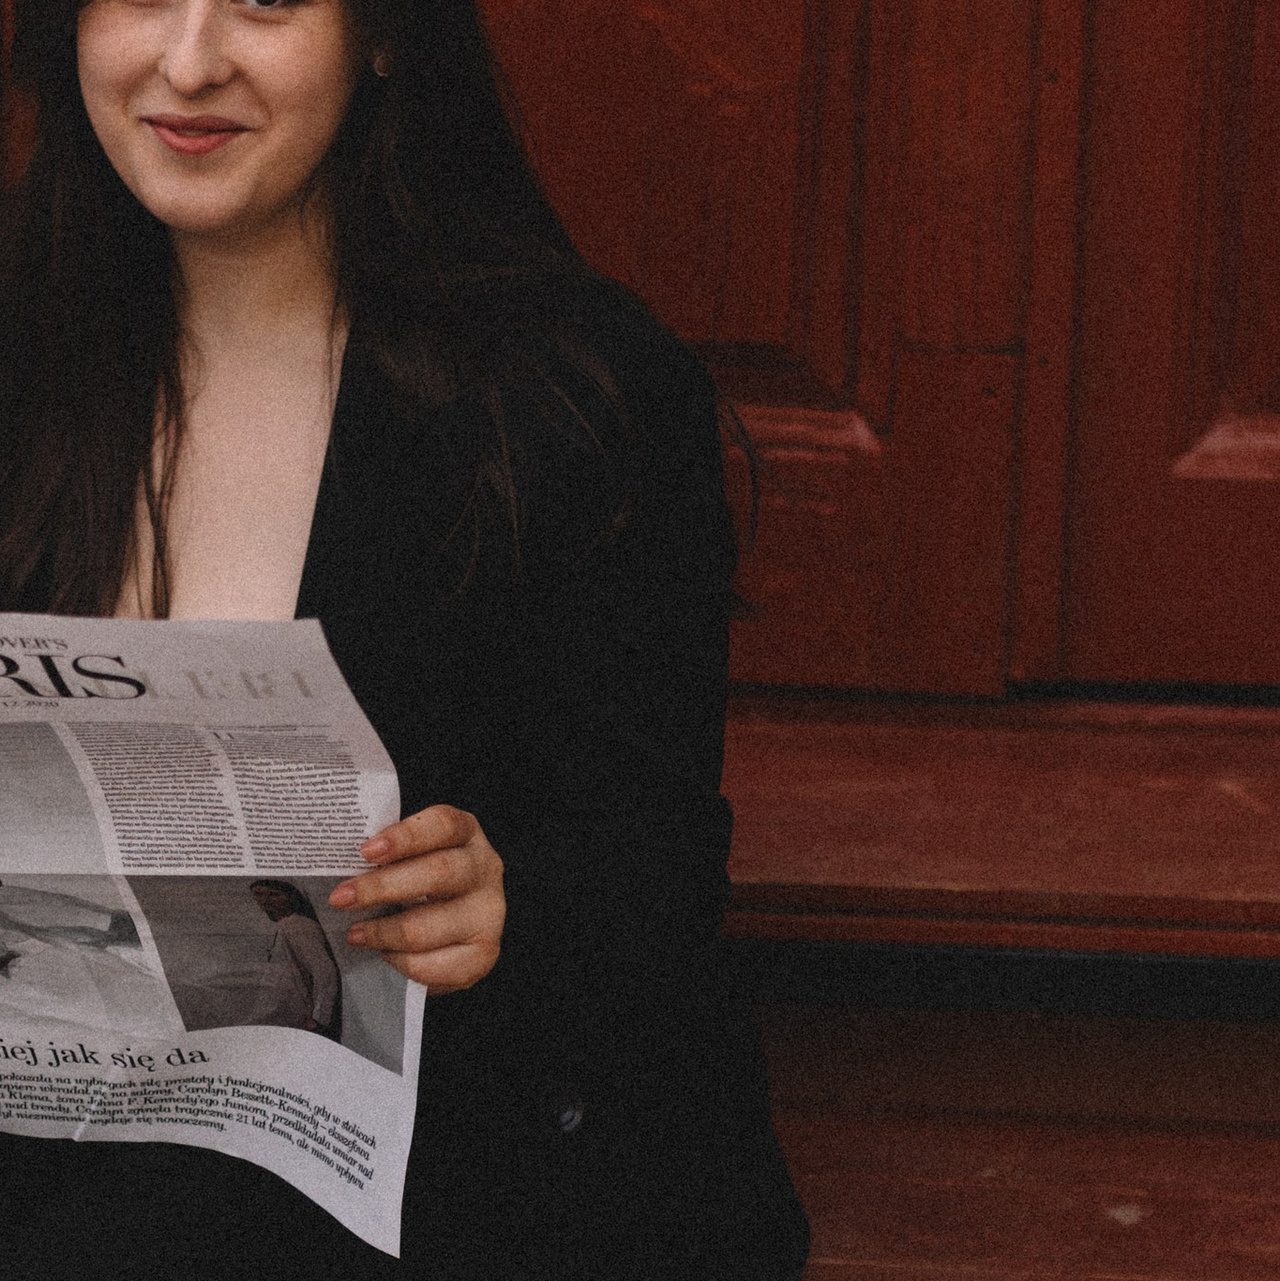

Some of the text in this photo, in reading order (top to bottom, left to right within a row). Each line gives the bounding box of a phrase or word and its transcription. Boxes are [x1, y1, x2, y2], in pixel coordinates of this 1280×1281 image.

[46, 1041, 102, 1068] jak
[110, 1047, 156, 1072] się
[166, 1048, 210, 1067] da
[55, 1076, 72, 1085] na
[164, 1075, 214, 1088] prostoty
[314, 1105, 331, 1123] gdy
[332, 1114, 341, 1126] w
[341, 1120, 377, 1150] stolicach
[177, 1083, 228, 1097] Carolyn
[231, 1087, 319, 1130] Bessette-Kennedy
[4, 1101, 27, 1110] nad
[175, 1105, 234, 1121] tragicznie
[236, 1112, 249, 1125] 21
[252, 1116, 266, 1130] lat
[296, 1137, 310, 1152] ale
[311, 1146, 335, 1169] mimo
[332, 1145, 358, 1167] umiar
[358, 1163, 375, 1181] nad
